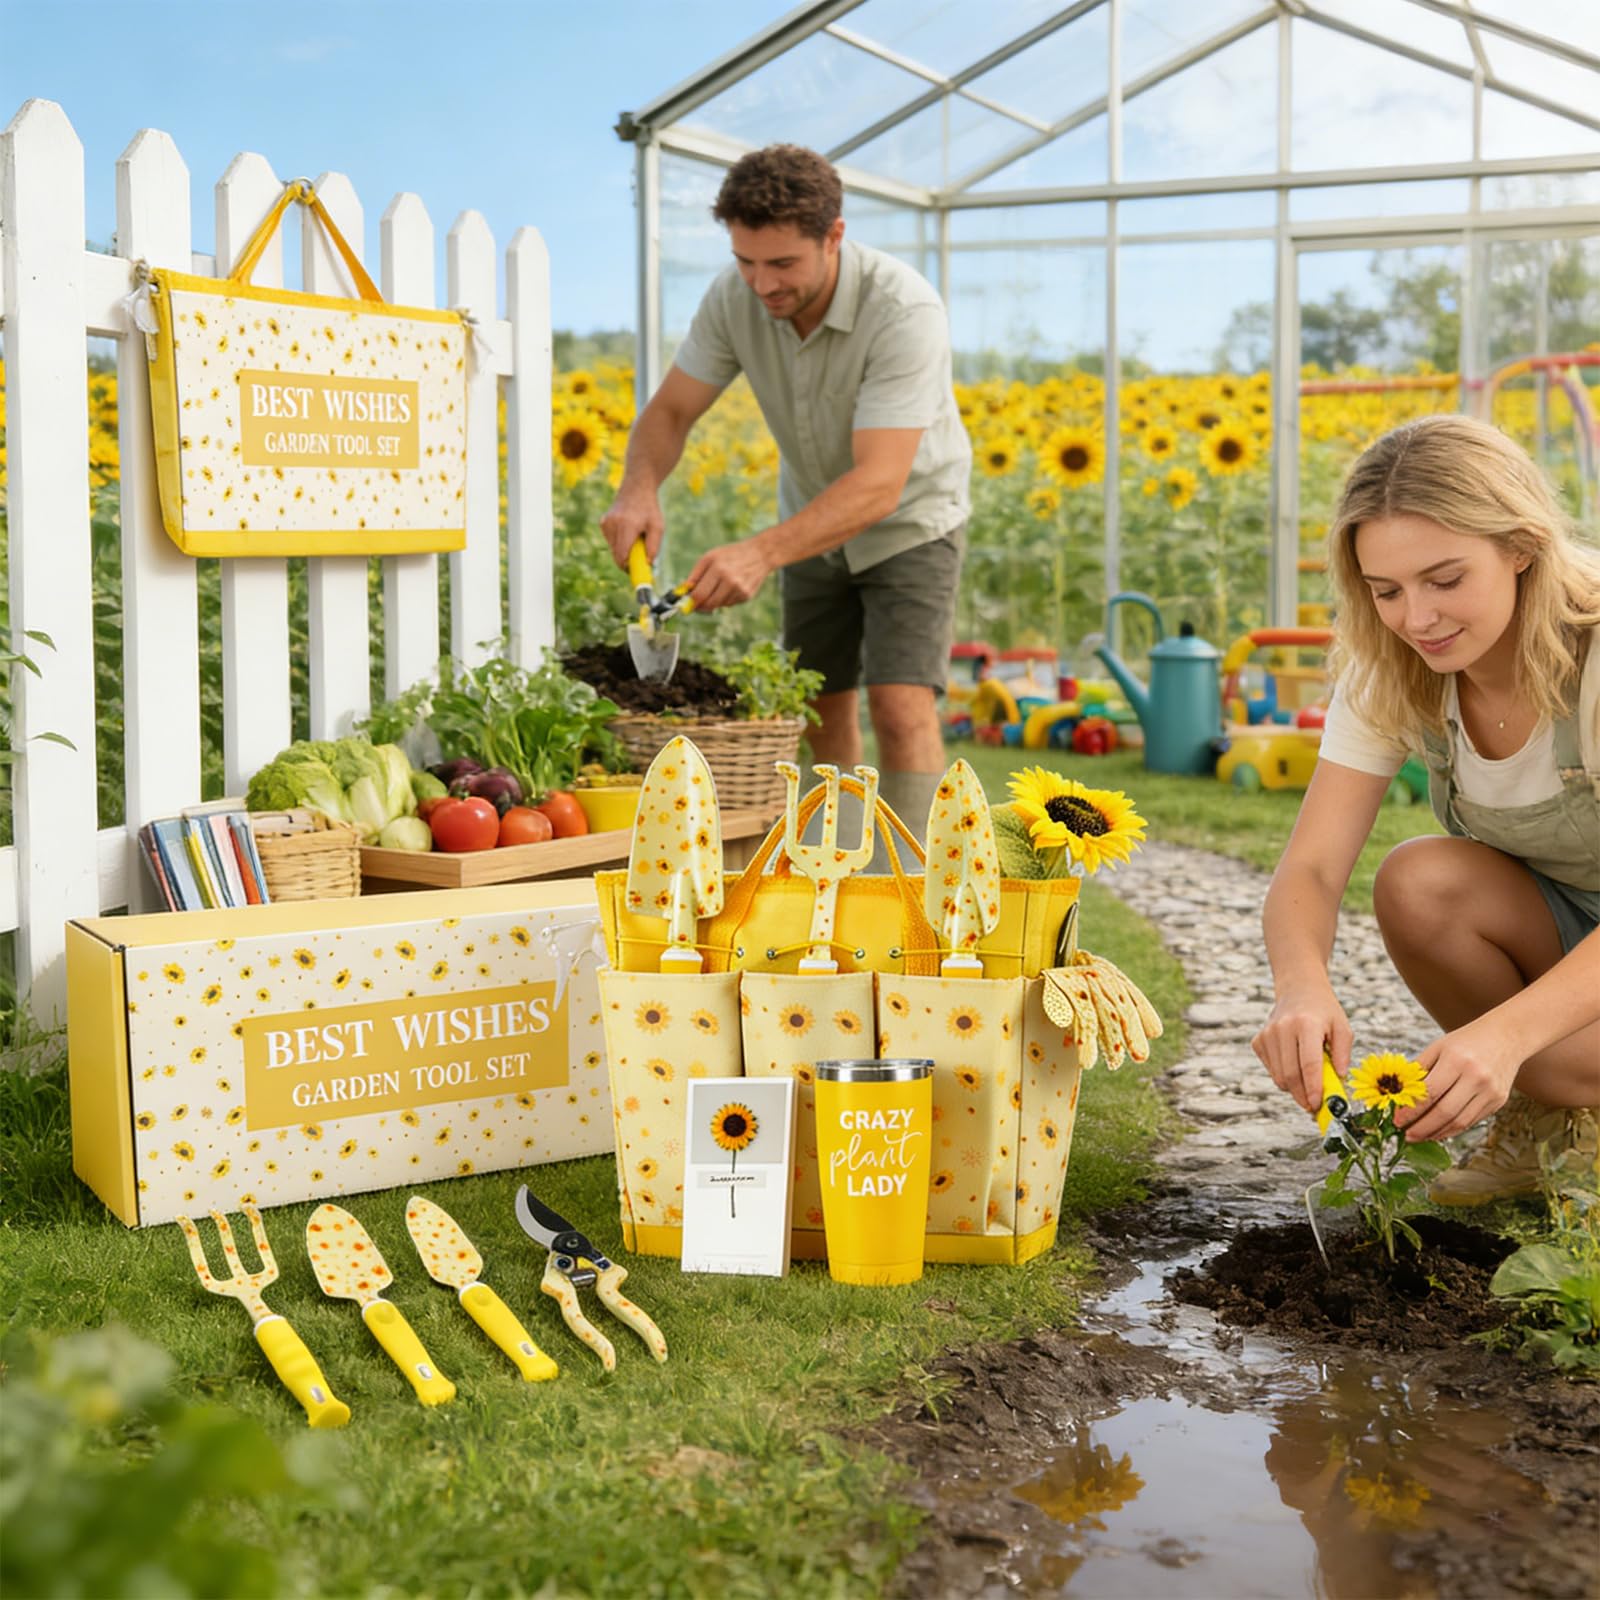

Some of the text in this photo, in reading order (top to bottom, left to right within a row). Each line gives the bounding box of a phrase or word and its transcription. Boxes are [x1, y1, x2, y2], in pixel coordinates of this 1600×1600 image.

[252, 384, 411, 423] BEST WISHES
[264, 432, 401, 456] GARDEN TOOL SET
[264, 998, 551, 1069] BEST WISHES
[292, 1053, 531, 1108] GARDEN TOOL SET
[829, 1131, 923, 1187] plant
[847, 1174, 908, 1197] LADY
